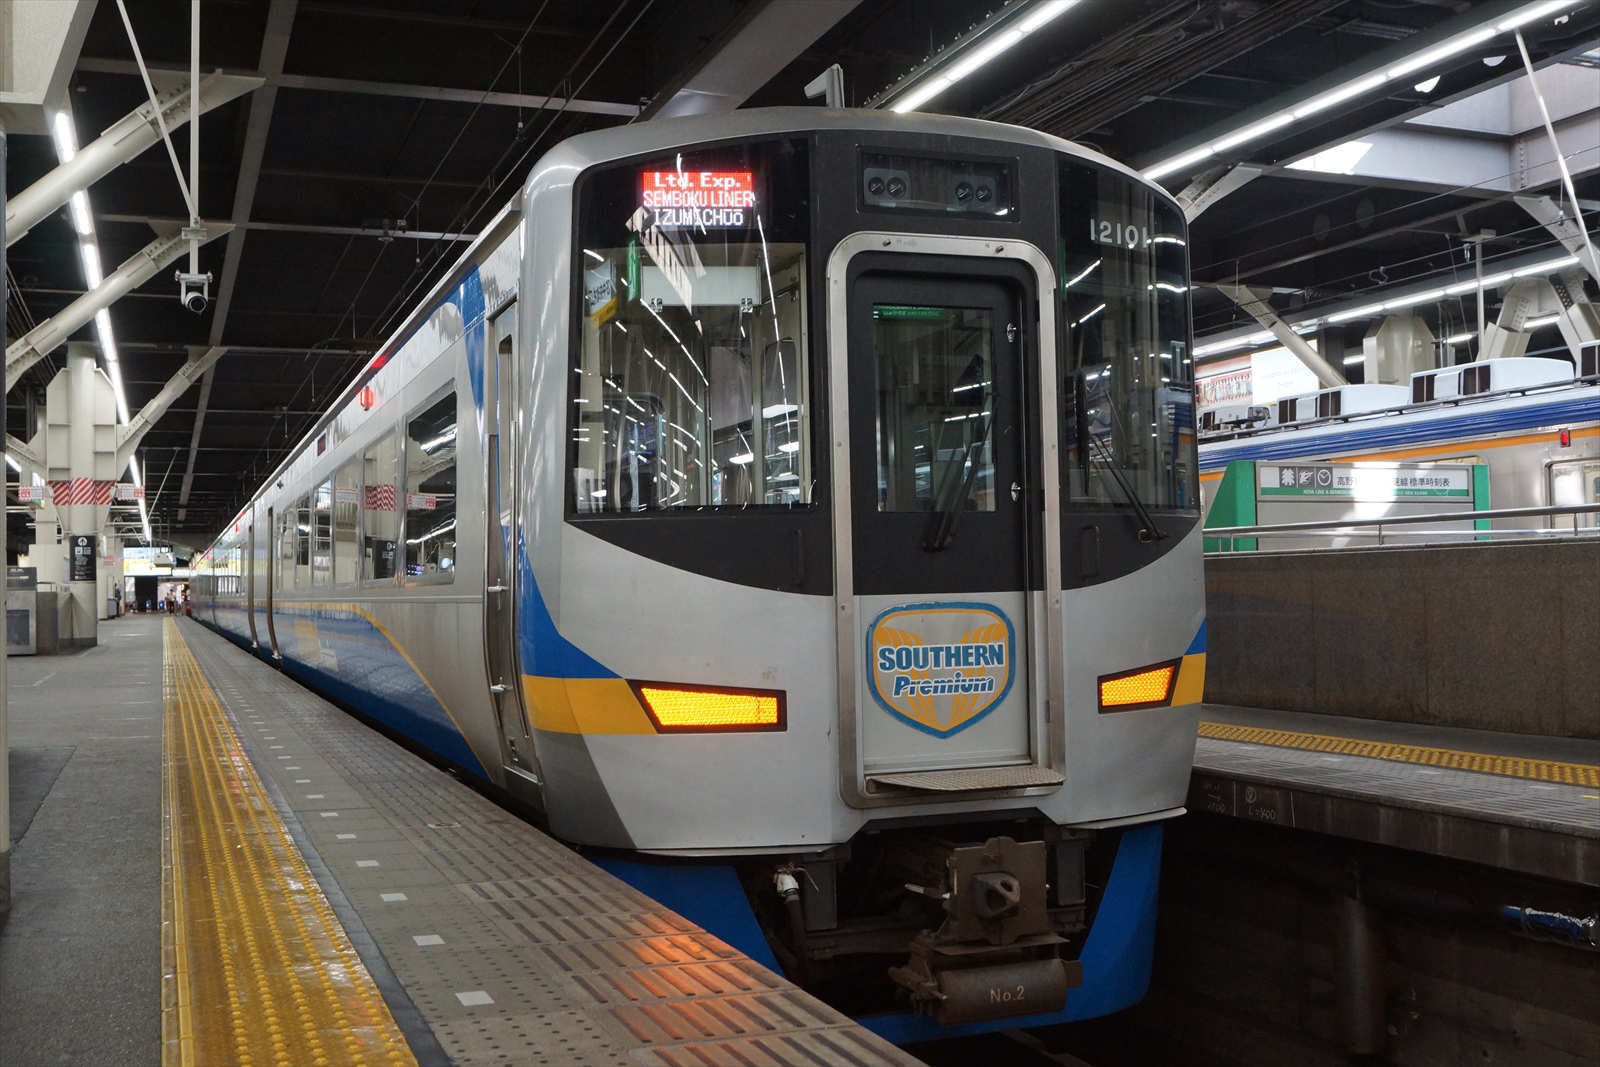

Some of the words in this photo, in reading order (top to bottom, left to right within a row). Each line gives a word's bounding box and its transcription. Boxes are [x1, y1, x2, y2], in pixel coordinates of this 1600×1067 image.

[654, 171, 694, 189] Ltd.
[700, 171, 741, 190] Exp.
[643, 190, 707, 207] SEMBOKU
[711, 190, 753, 207] LINER
[1090, 218, 1148, 248] 12101
[878, 643, 1005, 671] SOUTHERN
[893, 671, 995, 697] Premium
[990, 985, 1025, 1003] No.2
